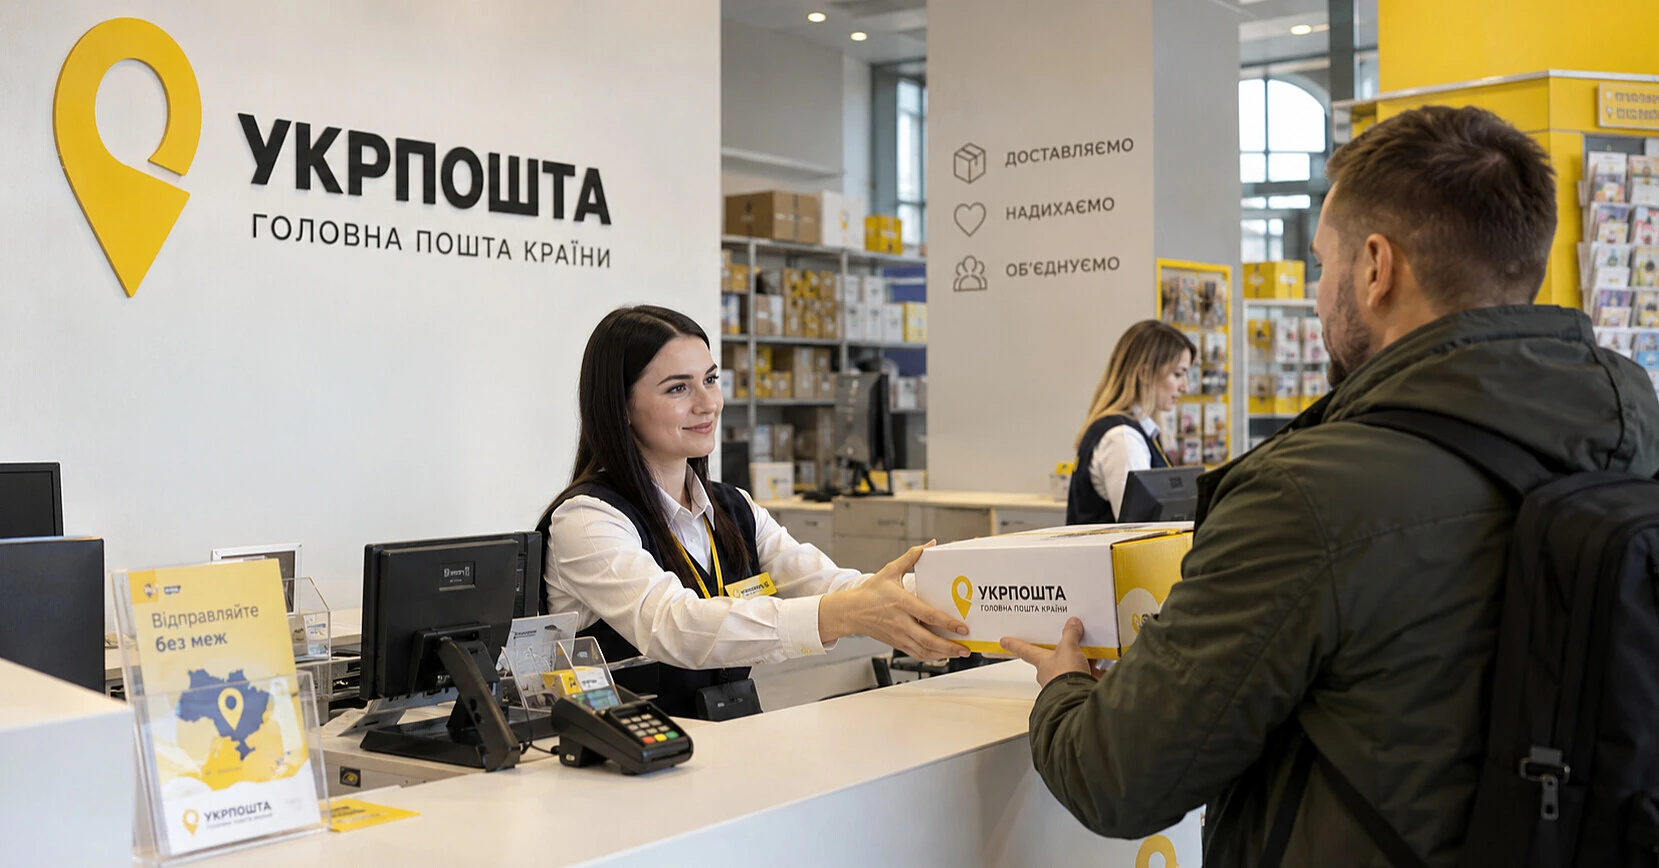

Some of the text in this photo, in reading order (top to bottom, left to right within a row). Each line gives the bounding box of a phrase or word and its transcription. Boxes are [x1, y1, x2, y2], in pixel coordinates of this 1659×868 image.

[1005, 138, 1134, 167] ДОСТАВЛЯЄМО
[237, 112, 612, 225] УКРПОШТА
[1006, 197, 1115, 221] НАДИХАЄМО
[252, 213, 611, 268] ГОЛОВНА ПОШТА КРАЇНИ
[1005, 256, 1120, 278] ОБ'ЄДНУЄМО
[978, 585, 1067, 601] УКРПОШТА
[152, 604, 259, 629] Відправляйте
[980, 604, 1068, 613] ГОЛОВНА ПОШТА КРАЇНИ
[155, 632, 228, 652] без меж
[204, 801, 272, 822] УКРПОШТА
